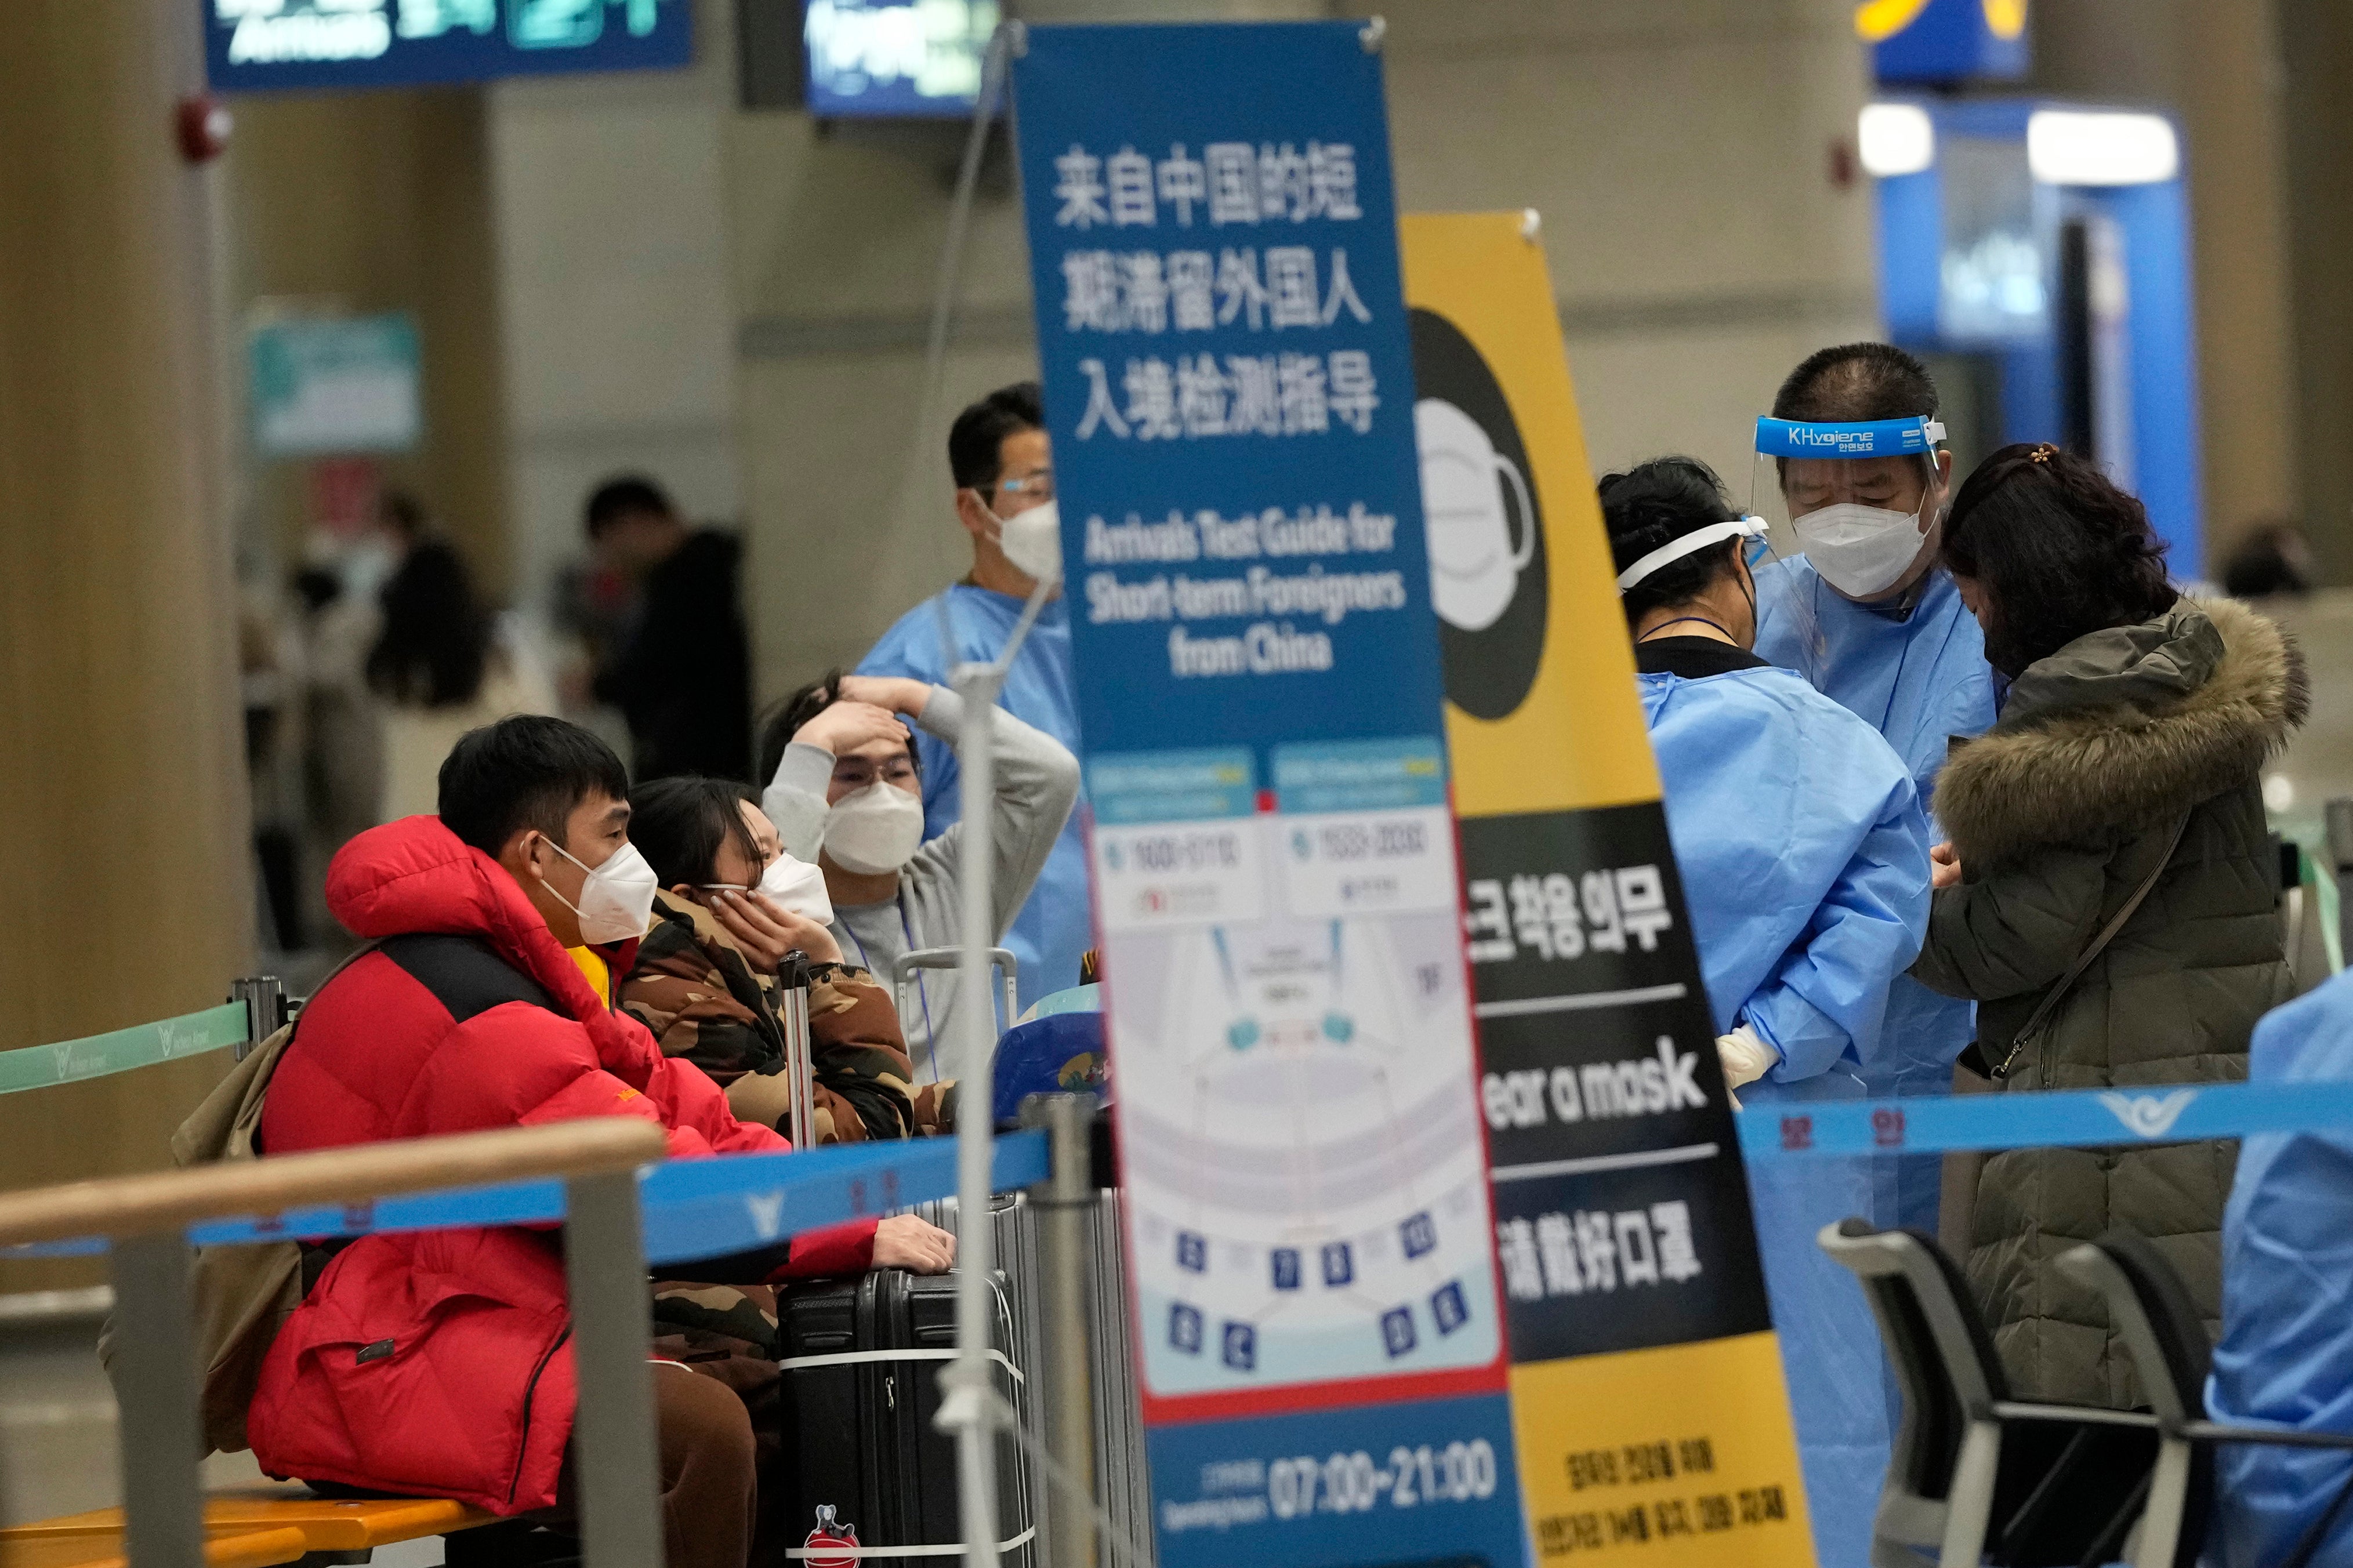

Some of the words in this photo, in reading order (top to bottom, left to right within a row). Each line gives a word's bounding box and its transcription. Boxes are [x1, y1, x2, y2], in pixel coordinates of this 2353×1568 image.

[1052, 141, 1363, 230] 来自中国的短
[1062, 244, 1373, 335] 期滞留外国人
[1075, 351, 1379, 441] 入境检测指导
[1085, 510, 1198, 564] Arrivals
[1197, 509, 1262, 560] Test
[1260, 503, 1347, 557] Guide
[1349, 502, 1396, 552] for
[1247, 563, 1406, 624] Foreigners
[1169, 625, 1244, 677] from
[1246, 622, 1333, 673] China
[1551, 1066, 1582, 1123] a
[1582, 1036, 1708, 1120] mask
